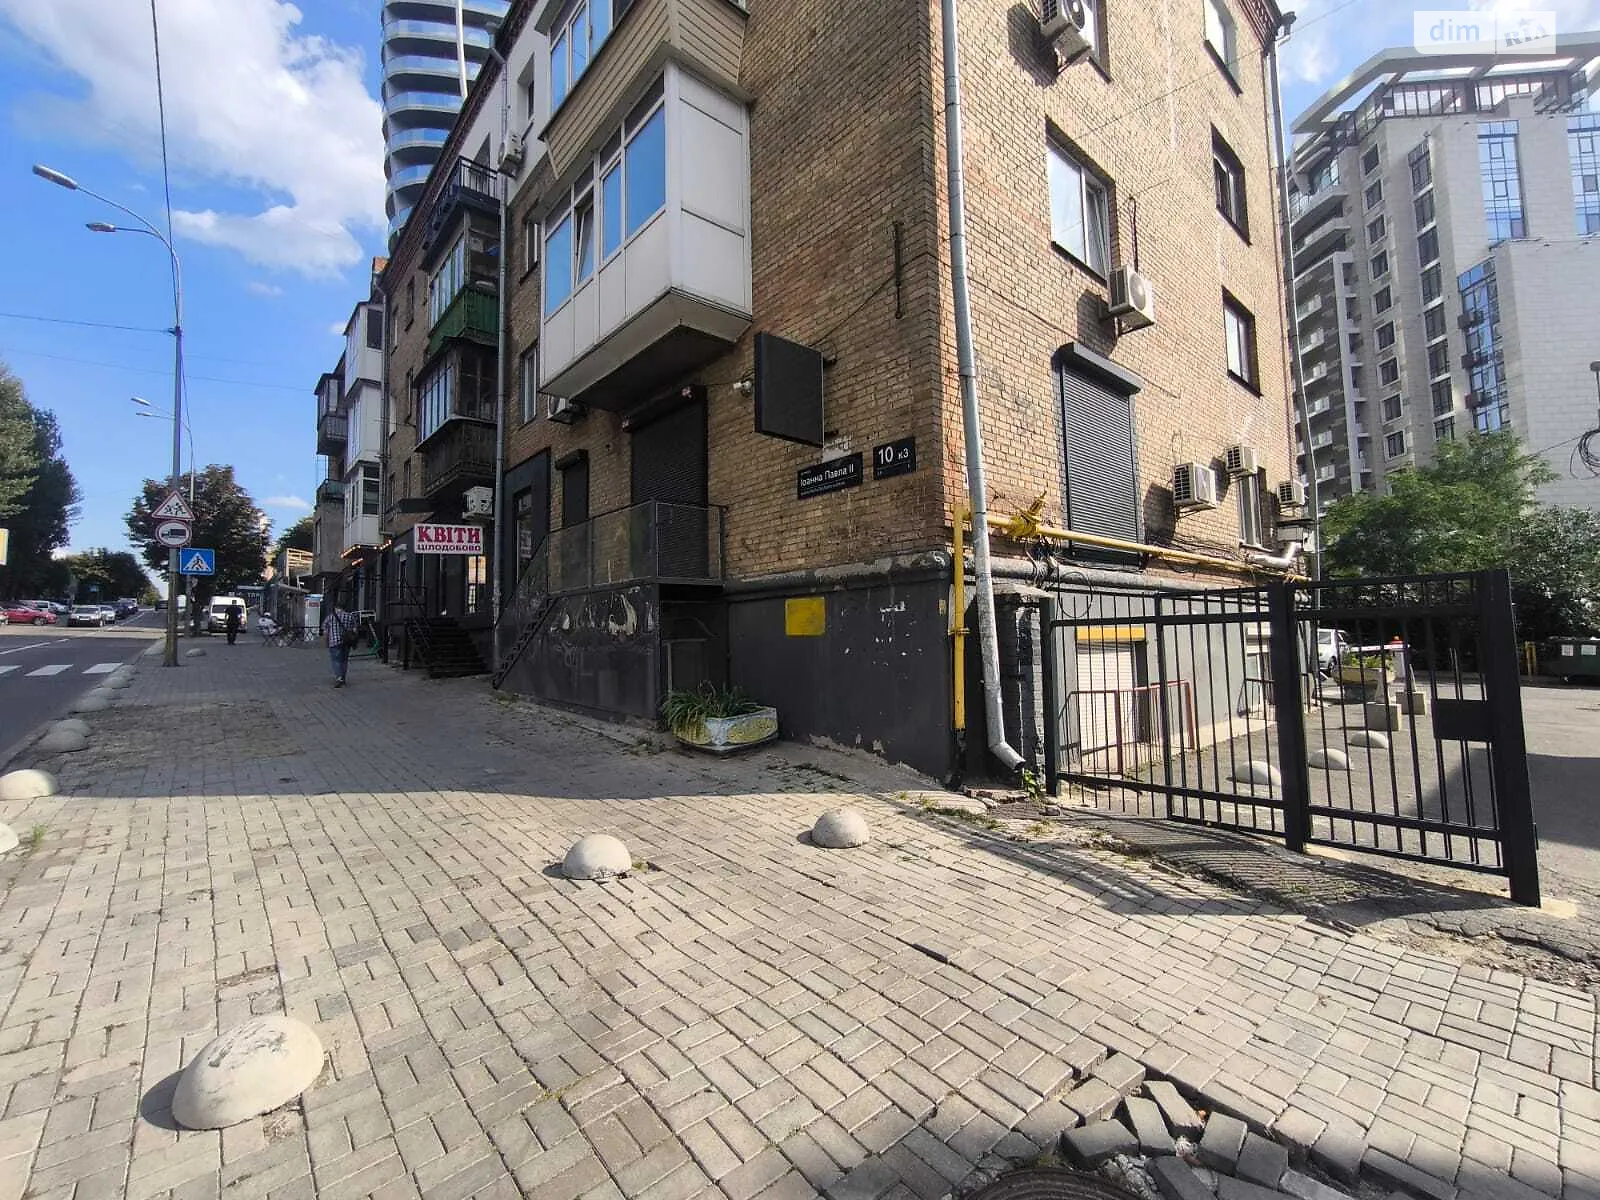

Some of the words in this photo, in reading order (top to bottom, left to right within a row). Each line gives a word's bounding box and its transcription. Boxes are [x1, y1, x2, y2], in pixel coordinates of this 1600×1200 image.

[878, 446, 894, 465] 10
[824, 469, 848, 480] Павла
[417, 526, 481, 543] КВІТИ
